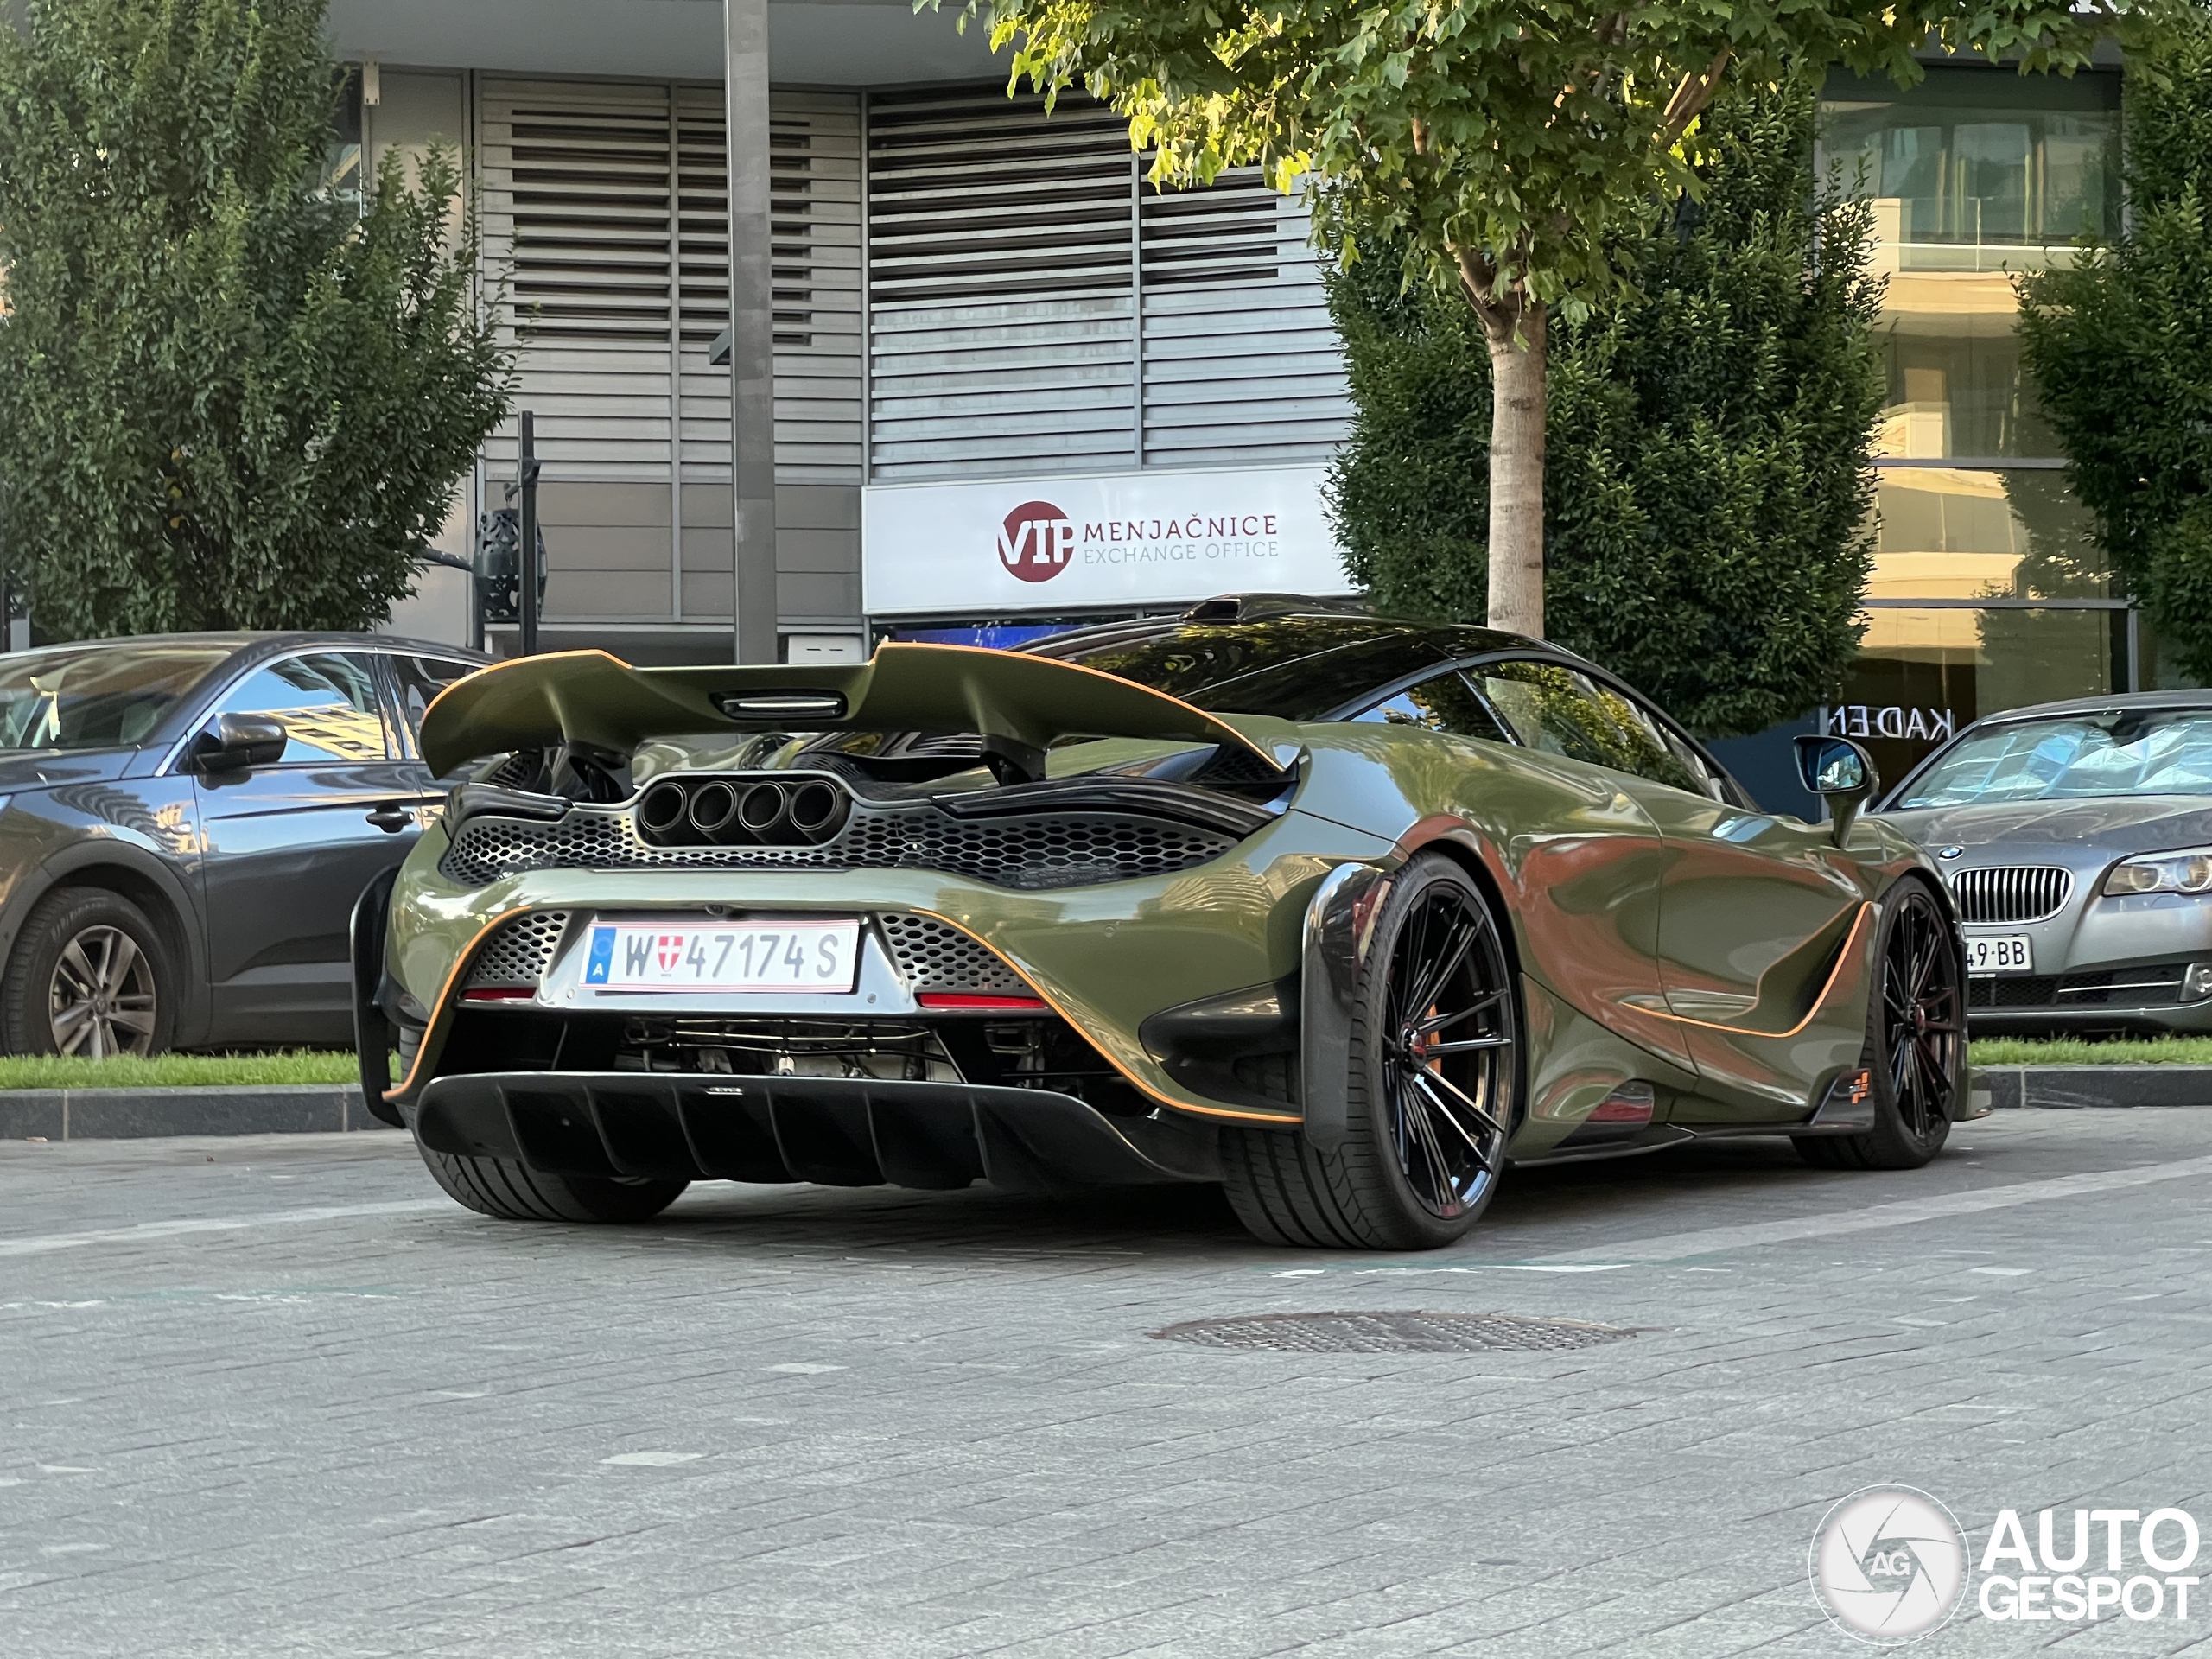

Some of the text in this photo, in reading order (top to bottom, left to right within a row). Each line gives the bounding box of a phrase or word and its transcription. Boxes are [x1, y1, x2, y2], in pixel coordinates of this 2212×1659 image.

[997, 518, 1075, 565] VIP
[1084, 513, 1277, 543] MENJAČNICE
[1084, 541, 1279, 564] EXCHANGE OFFICE
[593, 963, 604, 976] A
[626, 933, 839, 978] W 47174 S
